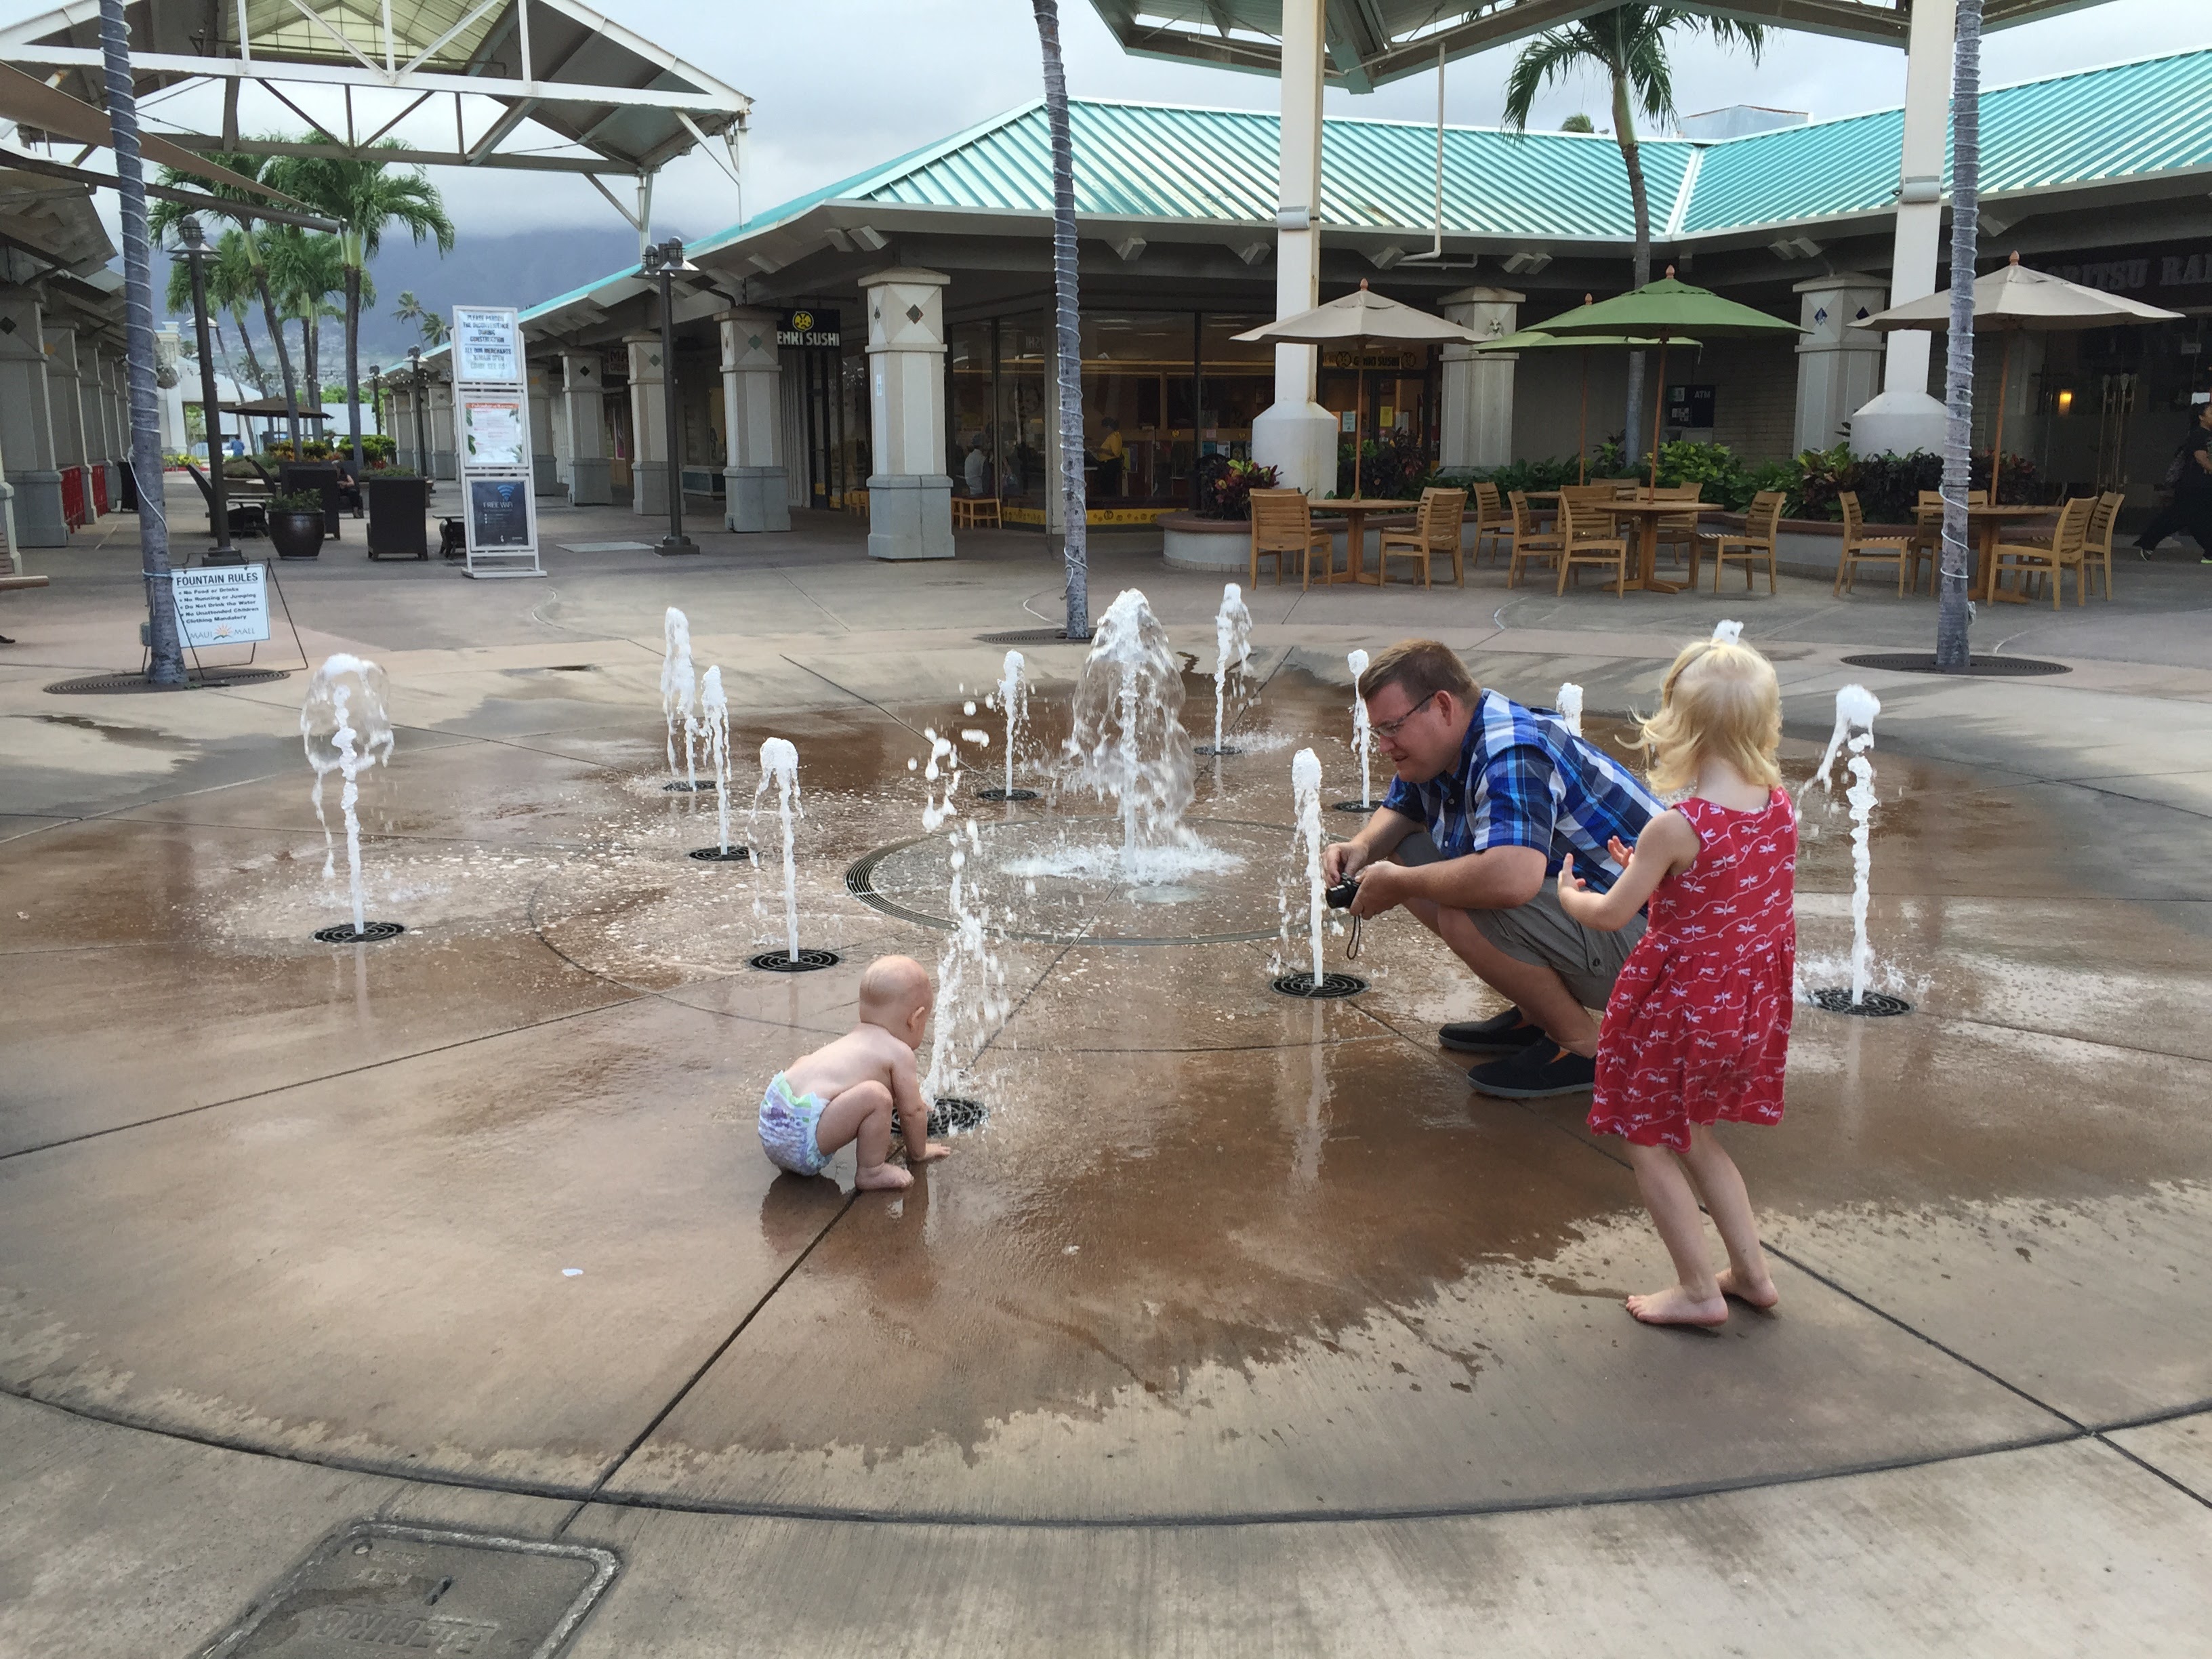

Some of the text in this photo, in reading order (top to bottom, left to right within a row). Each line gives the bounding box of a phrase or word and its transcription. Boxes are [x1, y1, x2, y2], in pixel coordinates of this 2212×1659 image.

[806, 332, 840, 346] SUSHI
[1353, 356, 1376, 366] GNKI
[1694, 390, 1711, 398] ATM
[176, 572, 258, 586] FOUNTAIN RULES
[190, 631, 212, 640] MAUI
[311, 1609, 500, 1655] ELECTRIC
